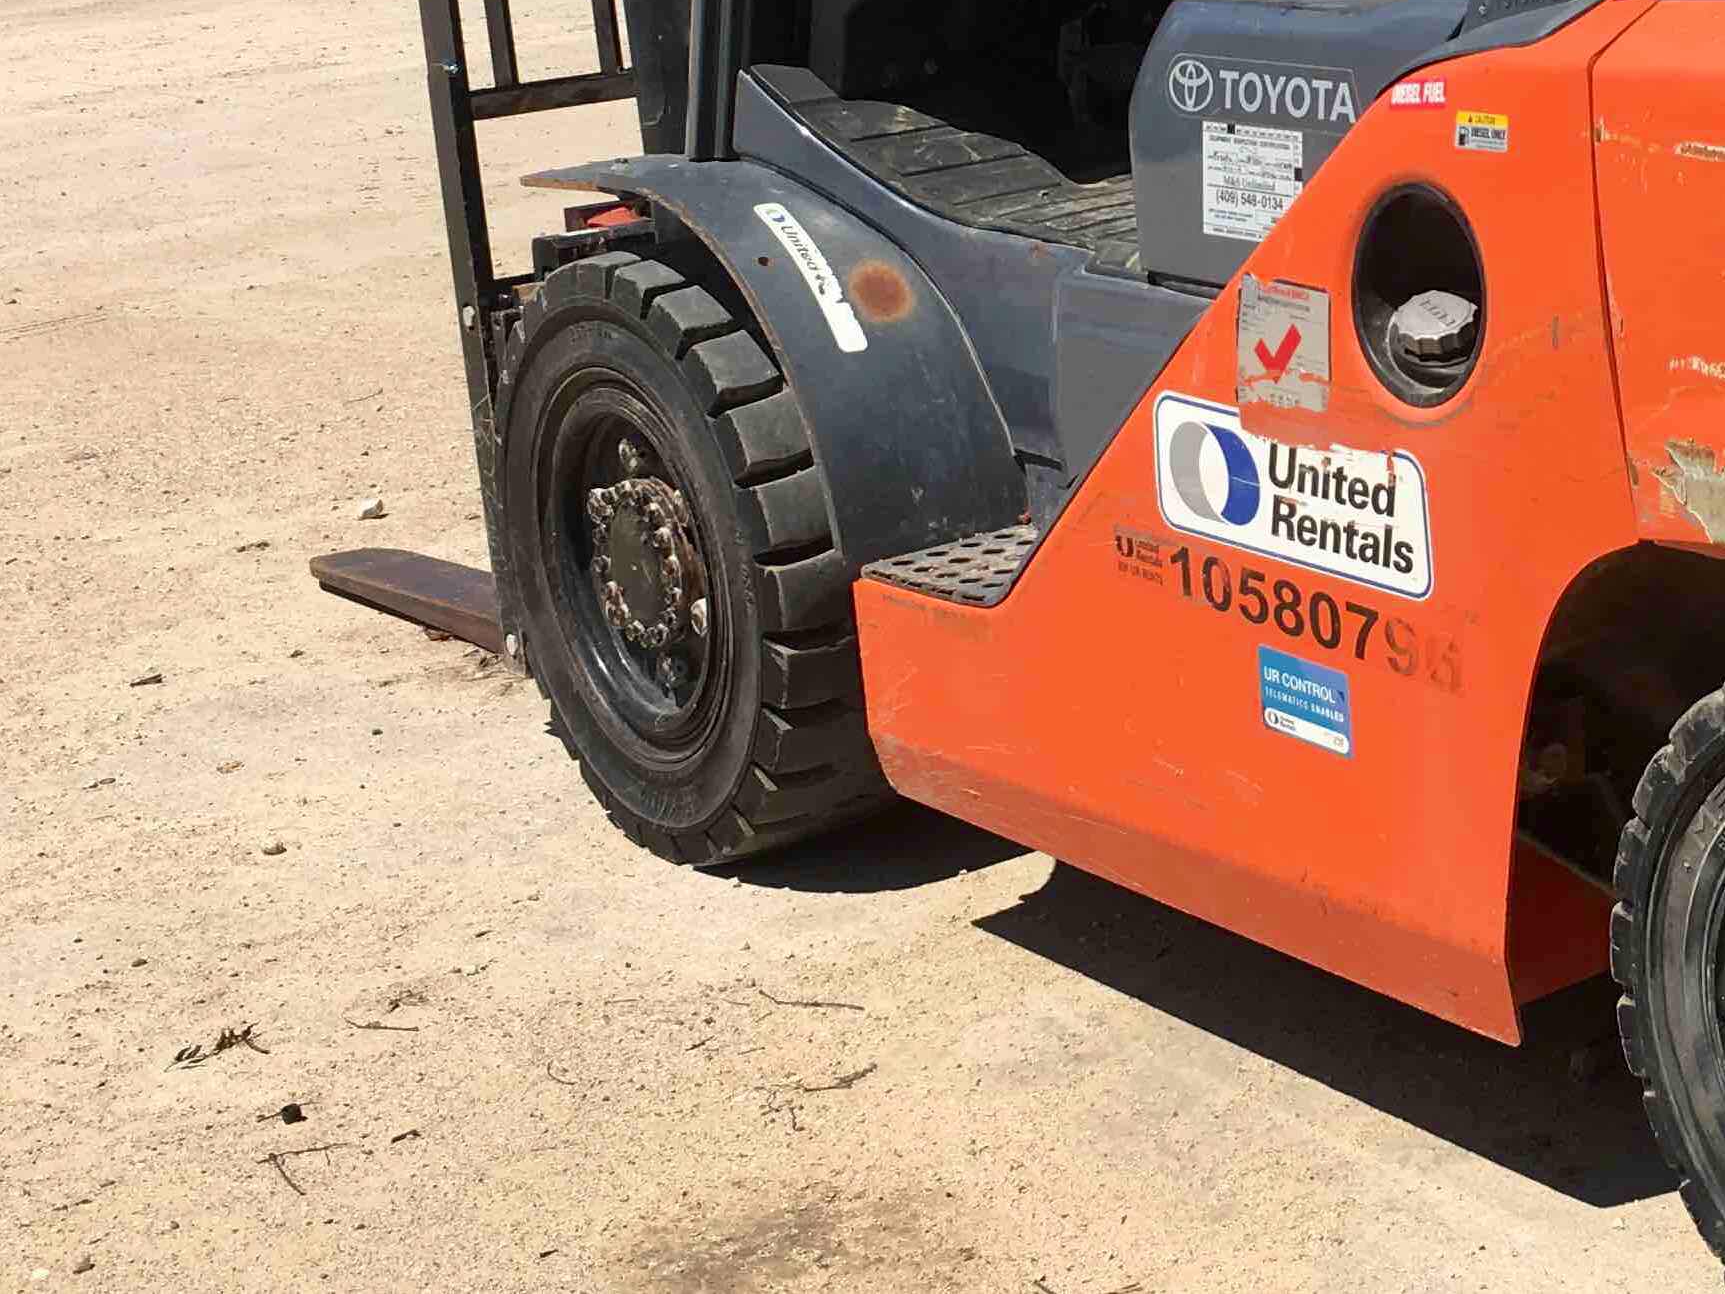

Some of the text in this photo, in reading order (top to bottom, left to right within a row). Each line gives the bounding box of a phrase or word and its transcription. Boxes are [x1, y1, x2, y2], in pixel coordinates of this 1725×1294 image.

[1218, 69, 1356, 123] TOYOTA
[1391, 81, 1446, 105] DIESEL FUEL
[781, 224, 819, 274] United
[1268, 443, 1397, 518] United
[1272, 494, 1415, 575] Rentals
[1263, 665, 1337, 705] UR CONTROL
